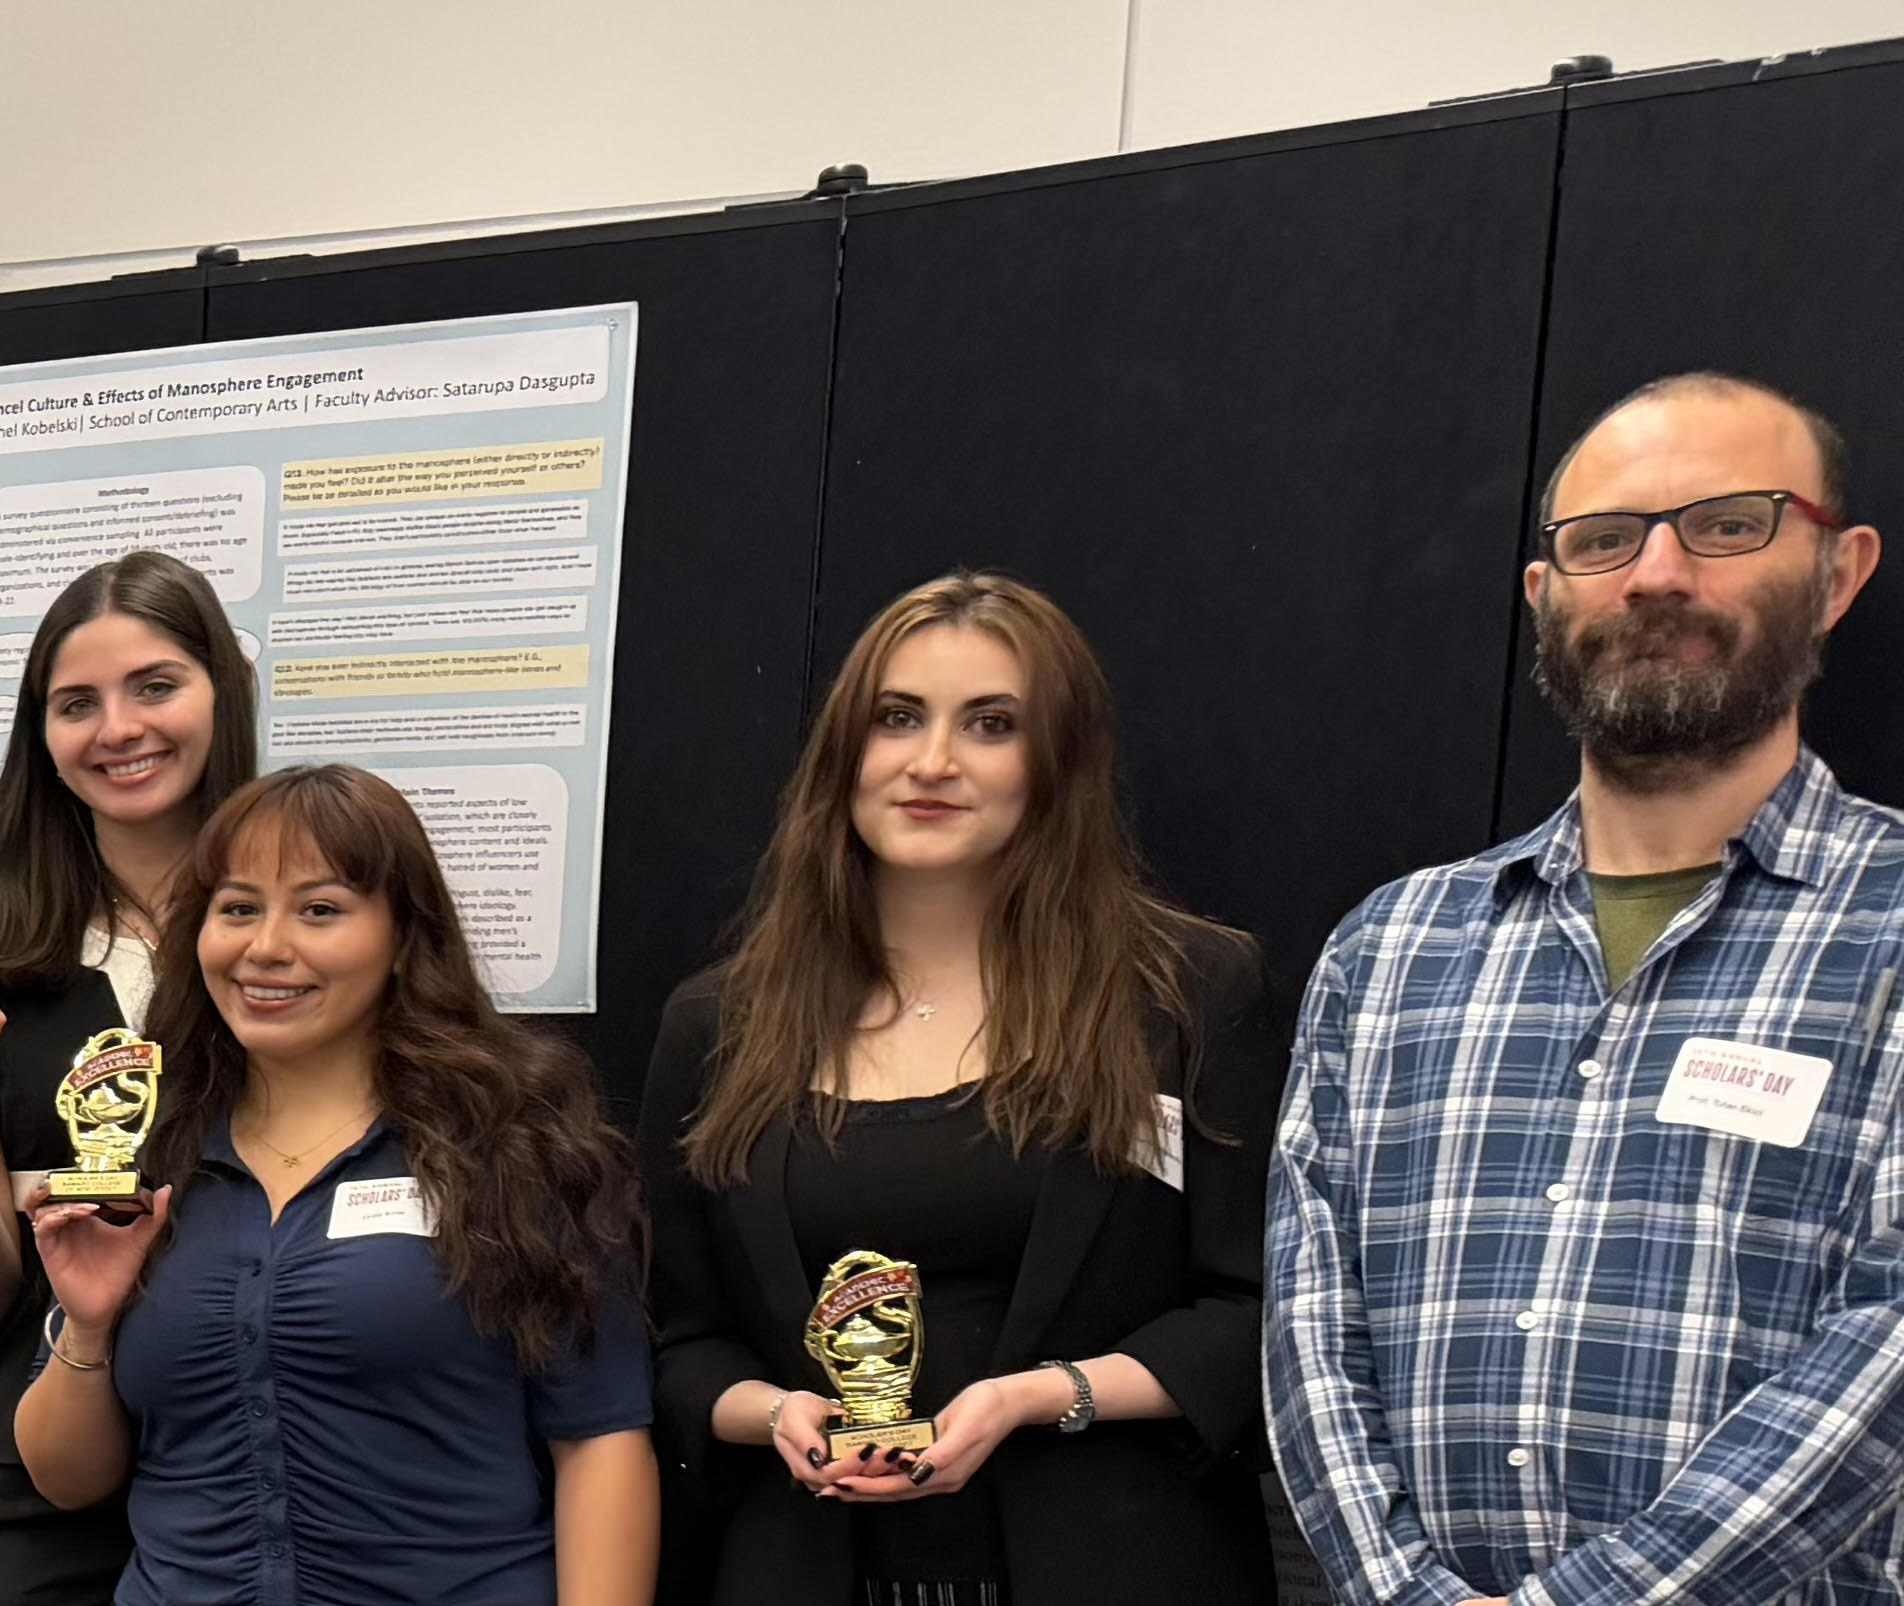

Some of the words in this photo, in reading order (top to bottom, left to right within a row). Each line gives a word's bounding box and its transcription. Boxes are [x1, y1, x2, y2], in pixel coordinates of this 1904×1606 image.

[28, 396, 78, 413] Culture
[82, 393, 93, 406] &
[98, 388, 144, 405] Effects
[148, 384, 164, 399] of
[167, 377, 263, 398] Manosphere
[267, 368, 364, 391] Engagement
[89, 413, 135, 430] School
[138, 410, 153, 424] of
[156, 400, 262, 423] Contemporary
[267, 397, 298, 413] Arts
[315, 391, 370, 409] Faculty
[373, 385, 439, 404] Advisor:
[443, 379, 514, 399] Satarupa
[519, 372, 596, 393] Dasgupta
[1683, 1058, 1765, 1089] SCHOLARS'
[1762, 1071, 1795, 1097] DAY
[821, 1282, 910, 1323] EXCELLENCE
